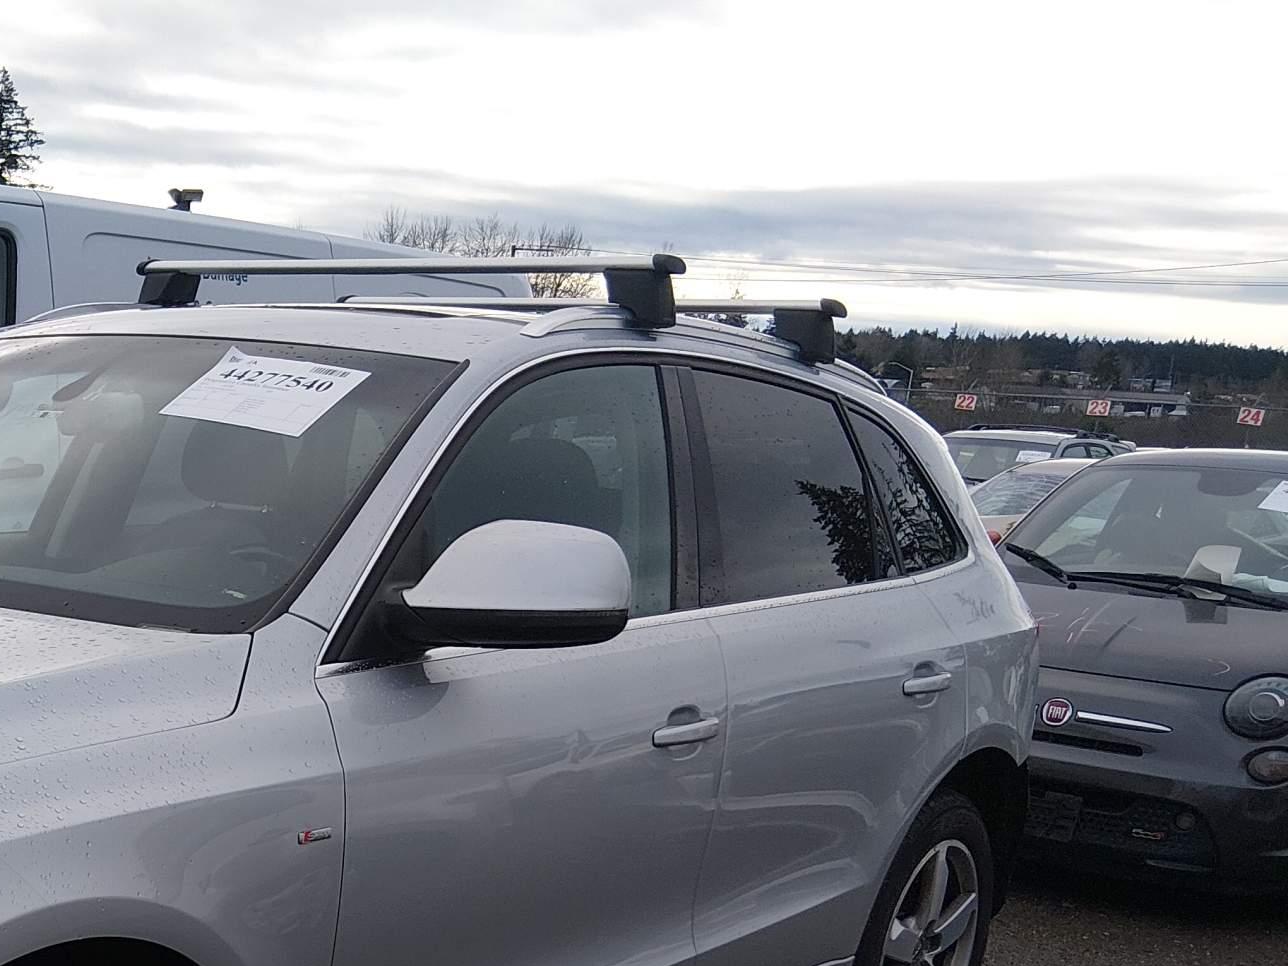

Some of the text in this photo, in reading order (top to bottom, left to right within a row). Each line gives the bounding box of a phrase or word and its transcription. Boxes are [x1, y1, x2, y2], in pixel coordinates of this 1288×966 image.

[219, 368, 334, 393] 44277540
[957, 395, 975, 408] 22
[1088, 401, 1108, 414] 23
[1240, 409, 1261, 424] 24
[1048, 705, 1067, 719] FIAT
